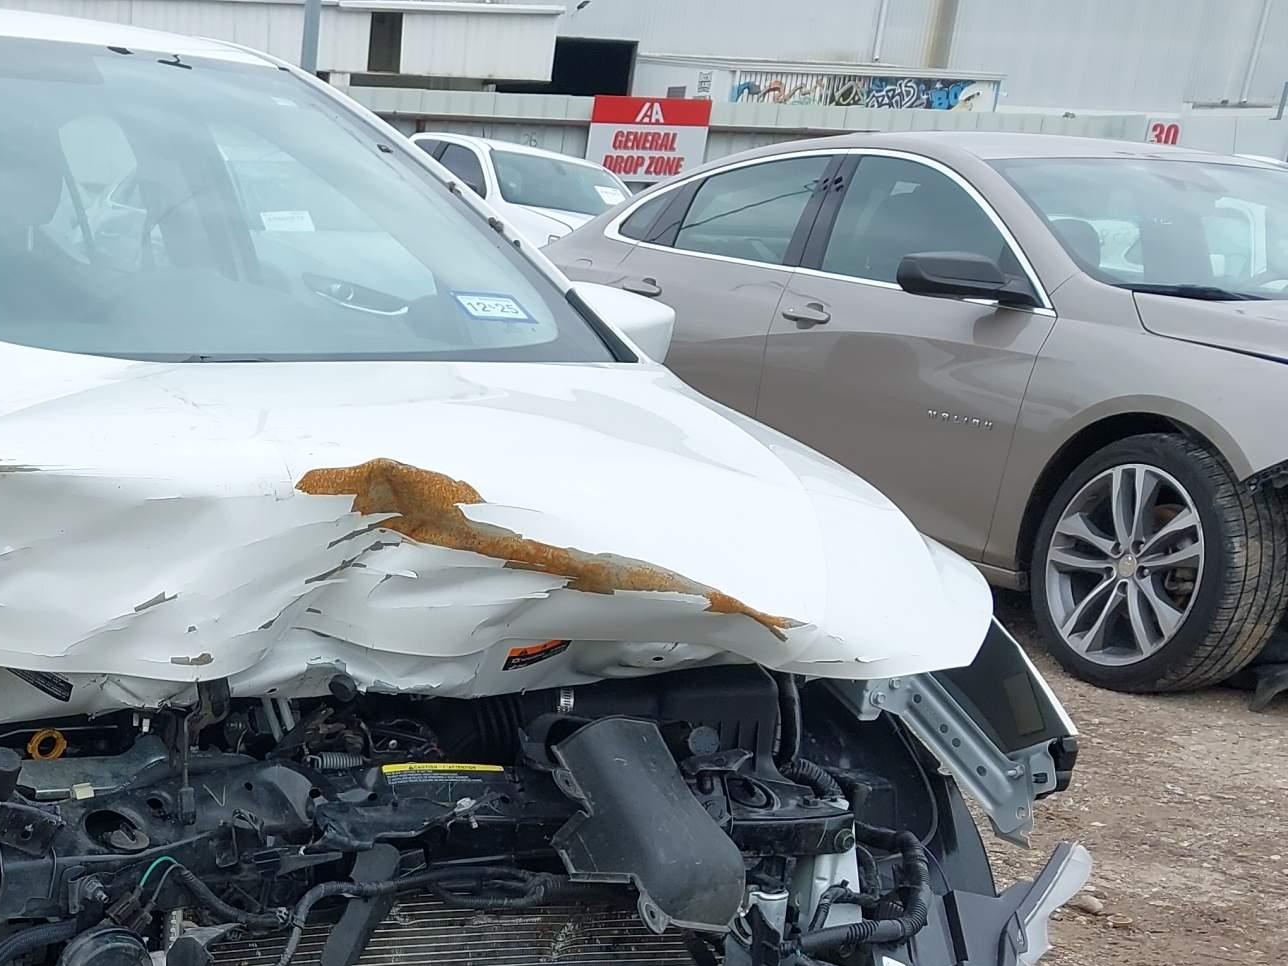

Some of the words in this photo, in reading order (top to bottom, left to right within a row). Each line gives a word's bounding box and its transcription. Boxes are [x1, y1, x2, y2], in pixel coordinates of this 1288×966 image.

[612, 130, 677, 152] GENERAL
[1152, 123, 1180, 145] 30
[603, 154, 646, 175] DROP
[644, 156, 684, 176] ZONE
